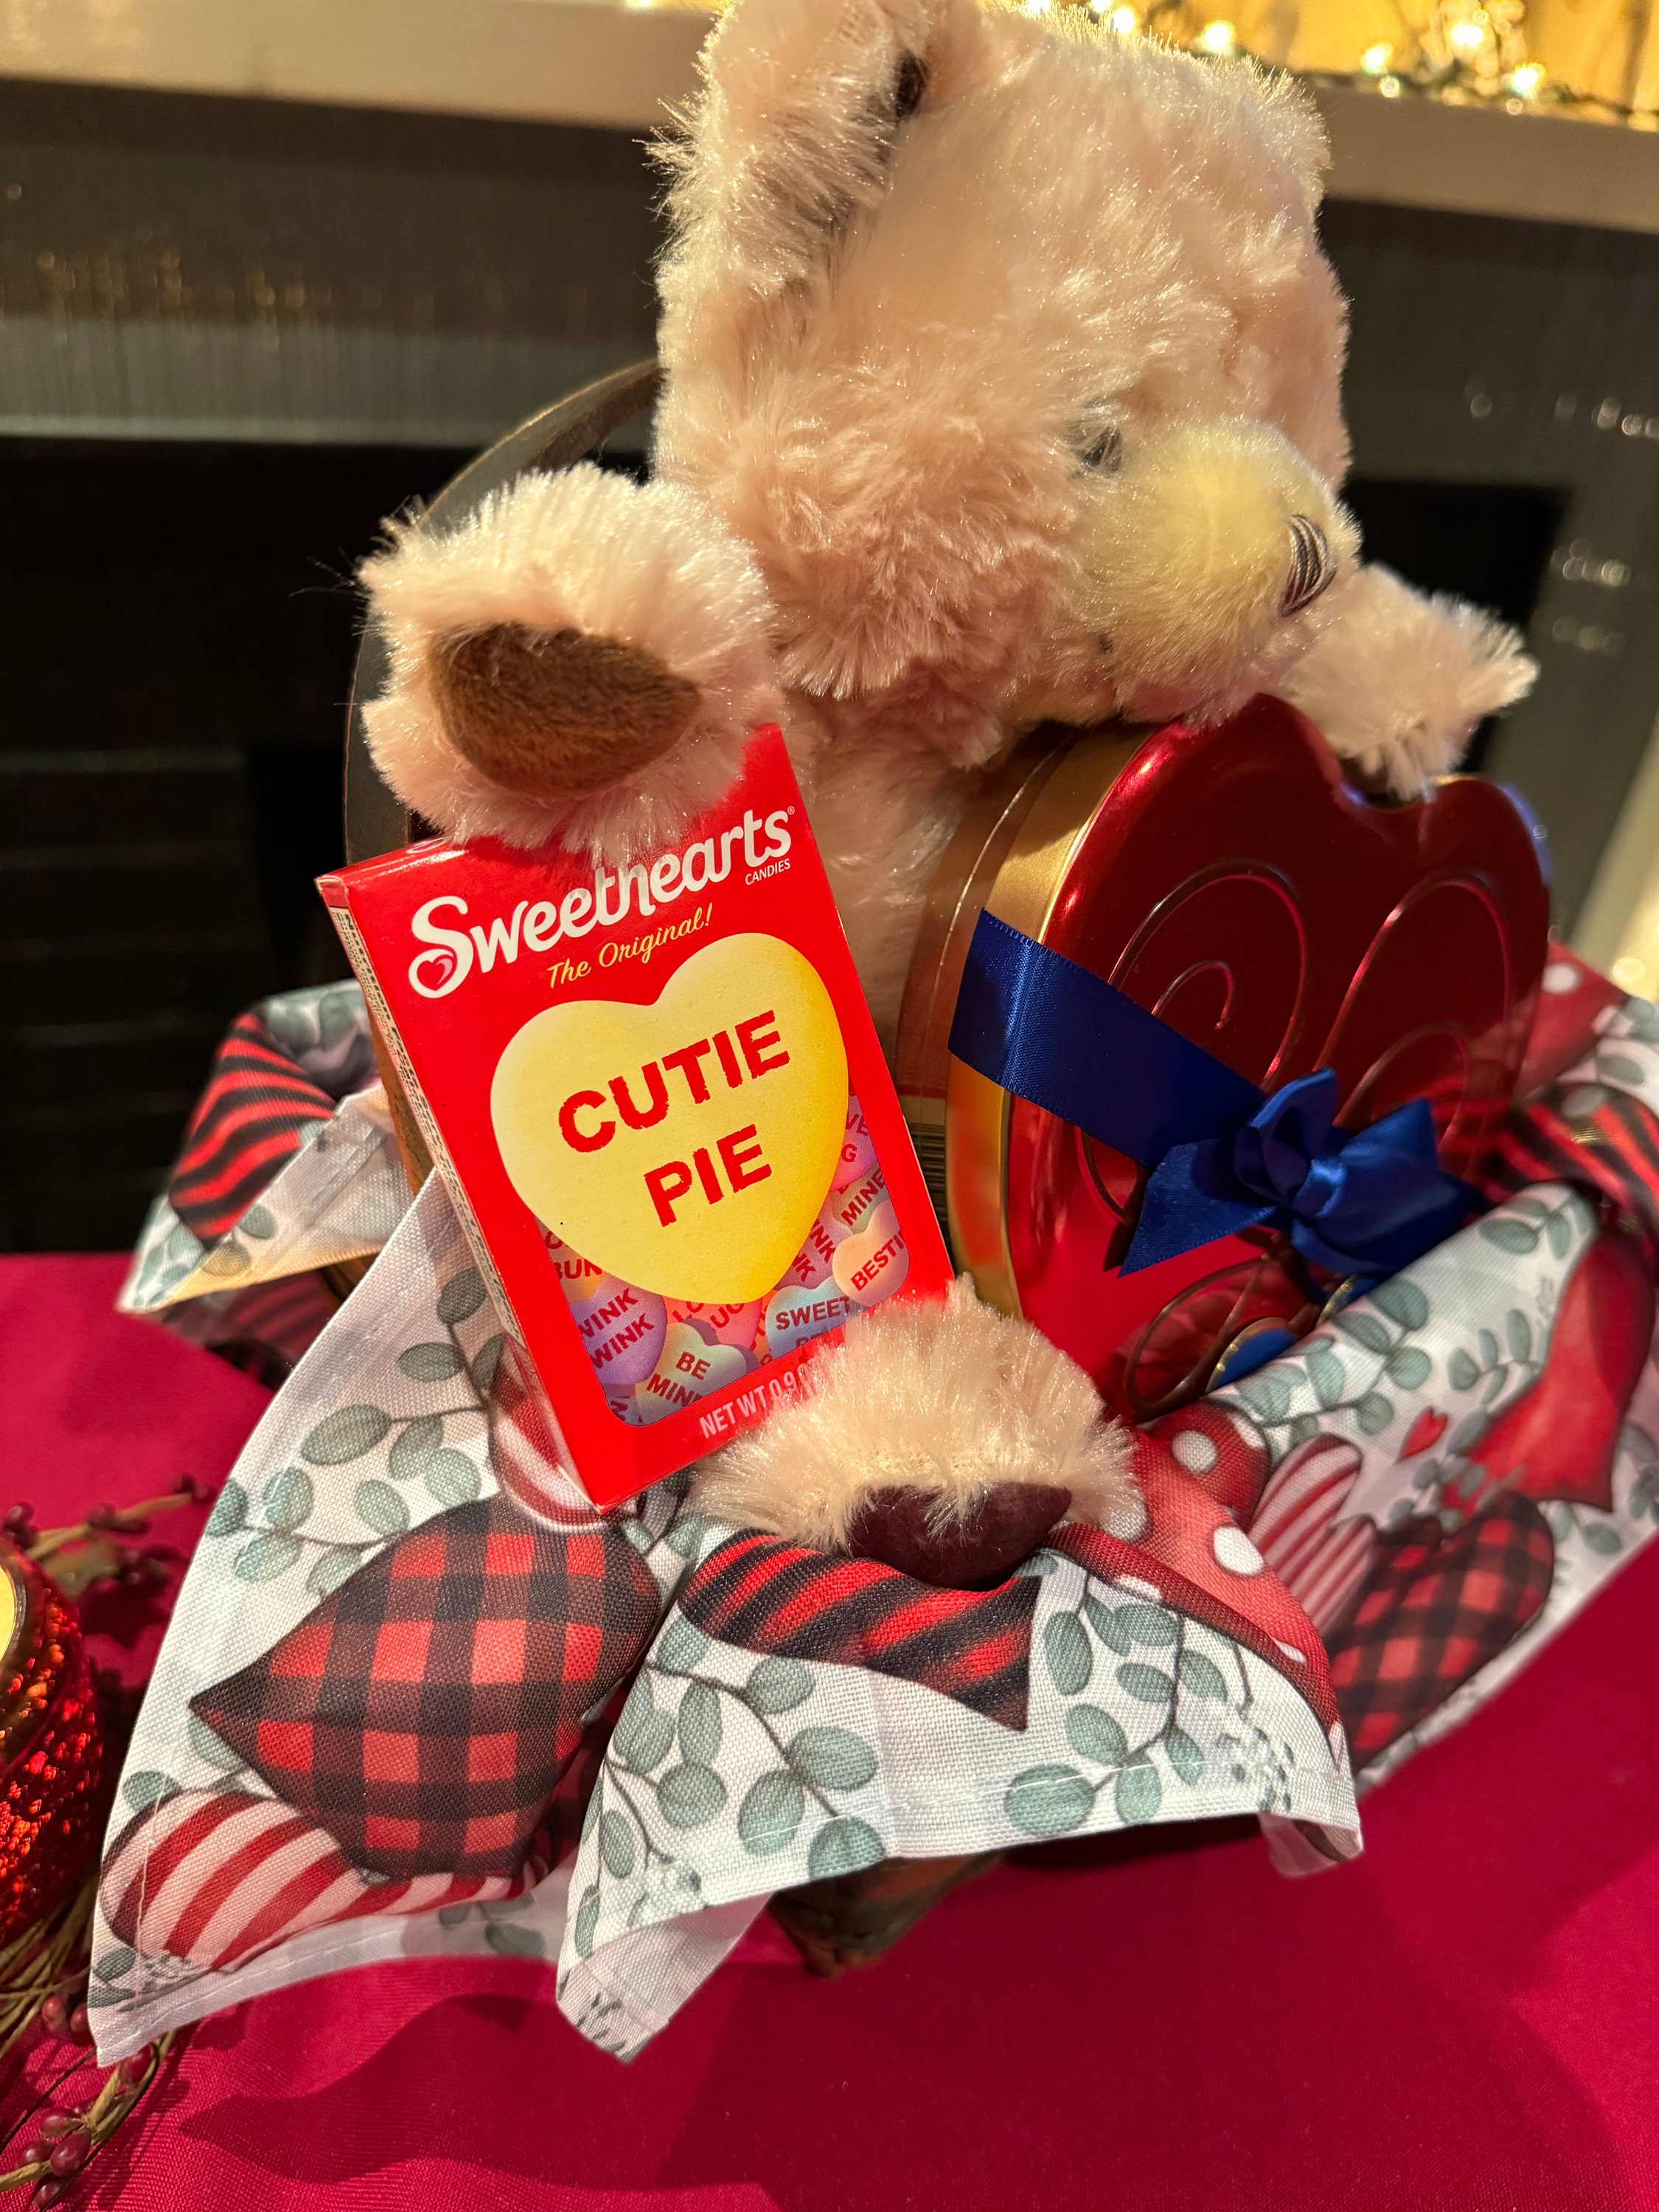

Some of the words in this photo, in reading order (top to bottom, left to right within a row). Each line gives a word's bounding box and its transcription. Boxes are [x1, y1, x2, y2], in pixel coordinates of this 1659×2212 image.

[745, 858, 790, 885] CANDIES
[408, 810, 791, 999] Sweethearts
[547, 958, 591, 989] The
[599, 902, 713, 964] Original!
[559, 1010, 790, 1152] CUTIE
[644, 1124, 772, 1227] PIE
[841, 1169, 886, 1226] MINE
[810, 1219, 835, 1263] INK
[850, 1229, 905, 1291] BESTI
[578, 1288, 639, 1338] WINK
[776, 1295, 850, 1330] SWEET
[591, 1313, 655, 1368] WINK
[675, 1351, 711, 1380] BE
[647, 1373, 704, 1406] MIN
[699, 1402, 737, 1439] NET
